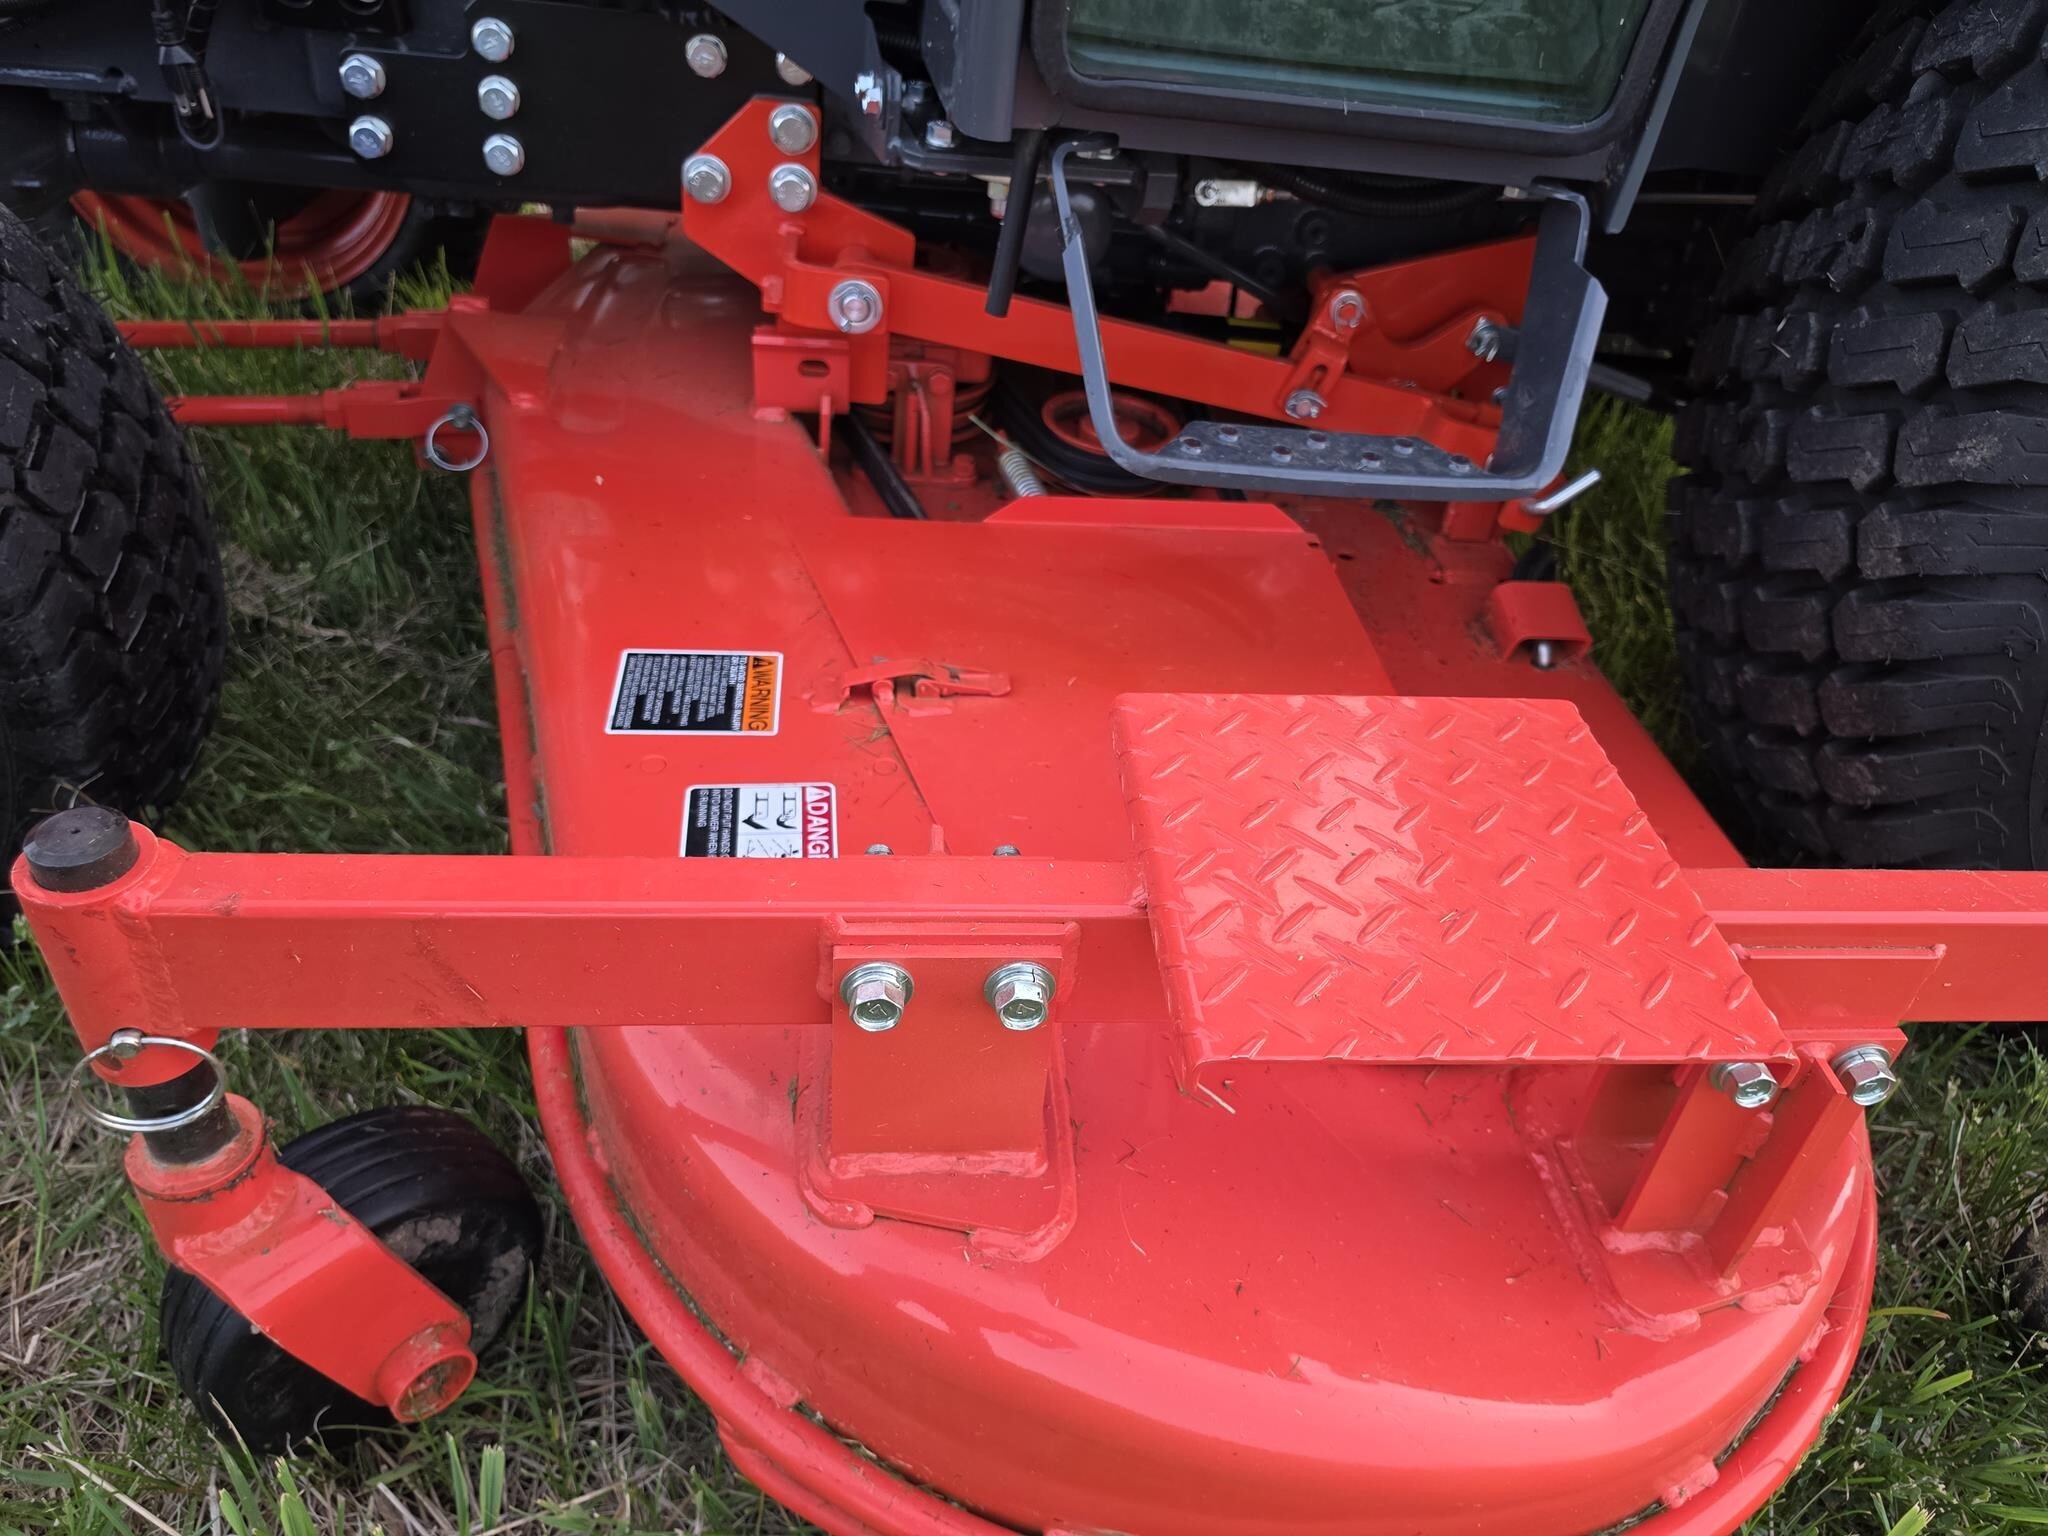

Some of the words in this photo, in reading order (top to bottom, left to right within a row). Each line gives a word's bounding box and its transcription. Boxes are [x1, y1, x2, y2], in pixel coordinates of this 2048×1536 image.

[736, 665, 746, 682] AVOID
[734, 683, 744, 709] SERIOUS
[747, 670, 769, 731] WARNING
[732, 710, 742, 730] INJURY
[711, 790, 721, 804] INTO
[723, 789, 733, 798] DO
[697, 797, 707, 827] RUNNING
[722, 800, 732, 813] NOT
[709, 805, 720, 831] MOWER
[721, 814, 731, 827] PUT
[707, 832, 718, 853] WHEN
[720, 828, 730, 853] HANDS
